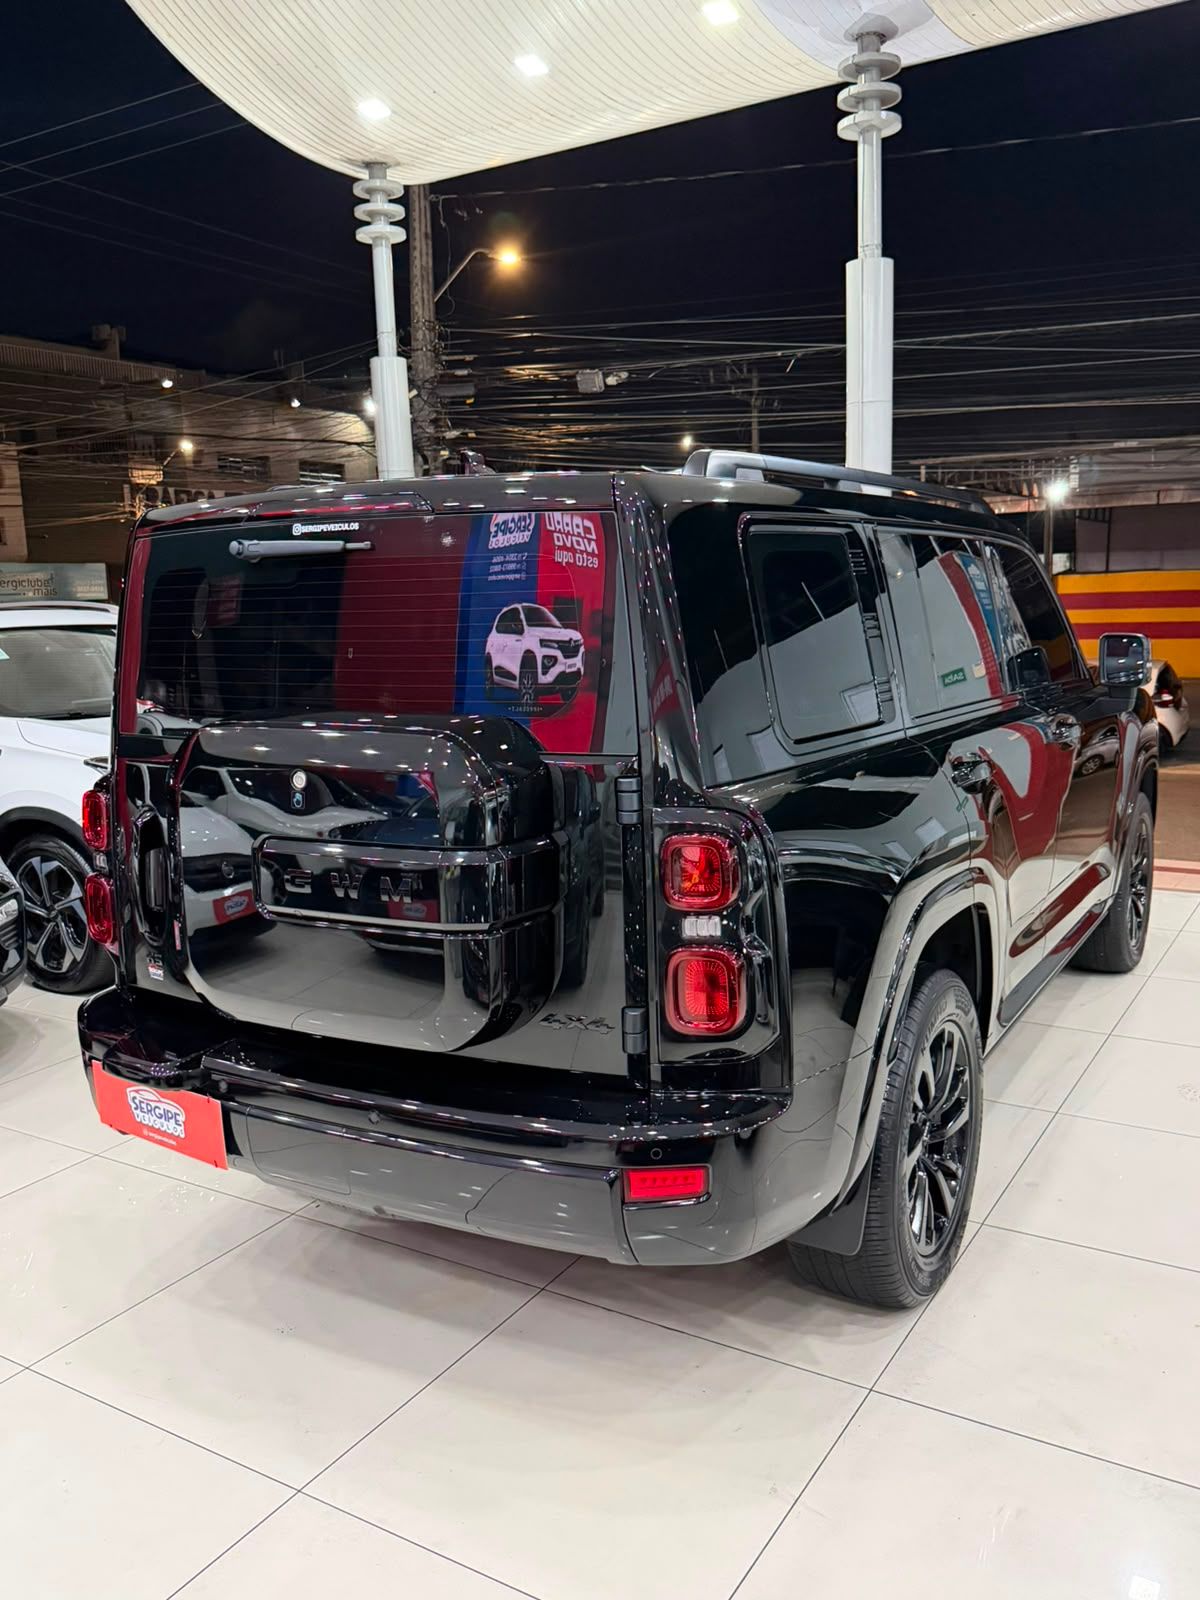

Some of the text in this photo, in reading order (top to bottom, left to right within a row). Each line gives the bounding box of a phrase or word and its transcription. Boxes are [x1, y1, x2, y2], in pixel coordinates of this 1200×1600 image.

[0, 577, 49, 591] ergiclube
[33, 587, 57, 596] mais
[284, 868, 412, 904] GWM
[131, 1095, 182, 1127] SERGIPE
